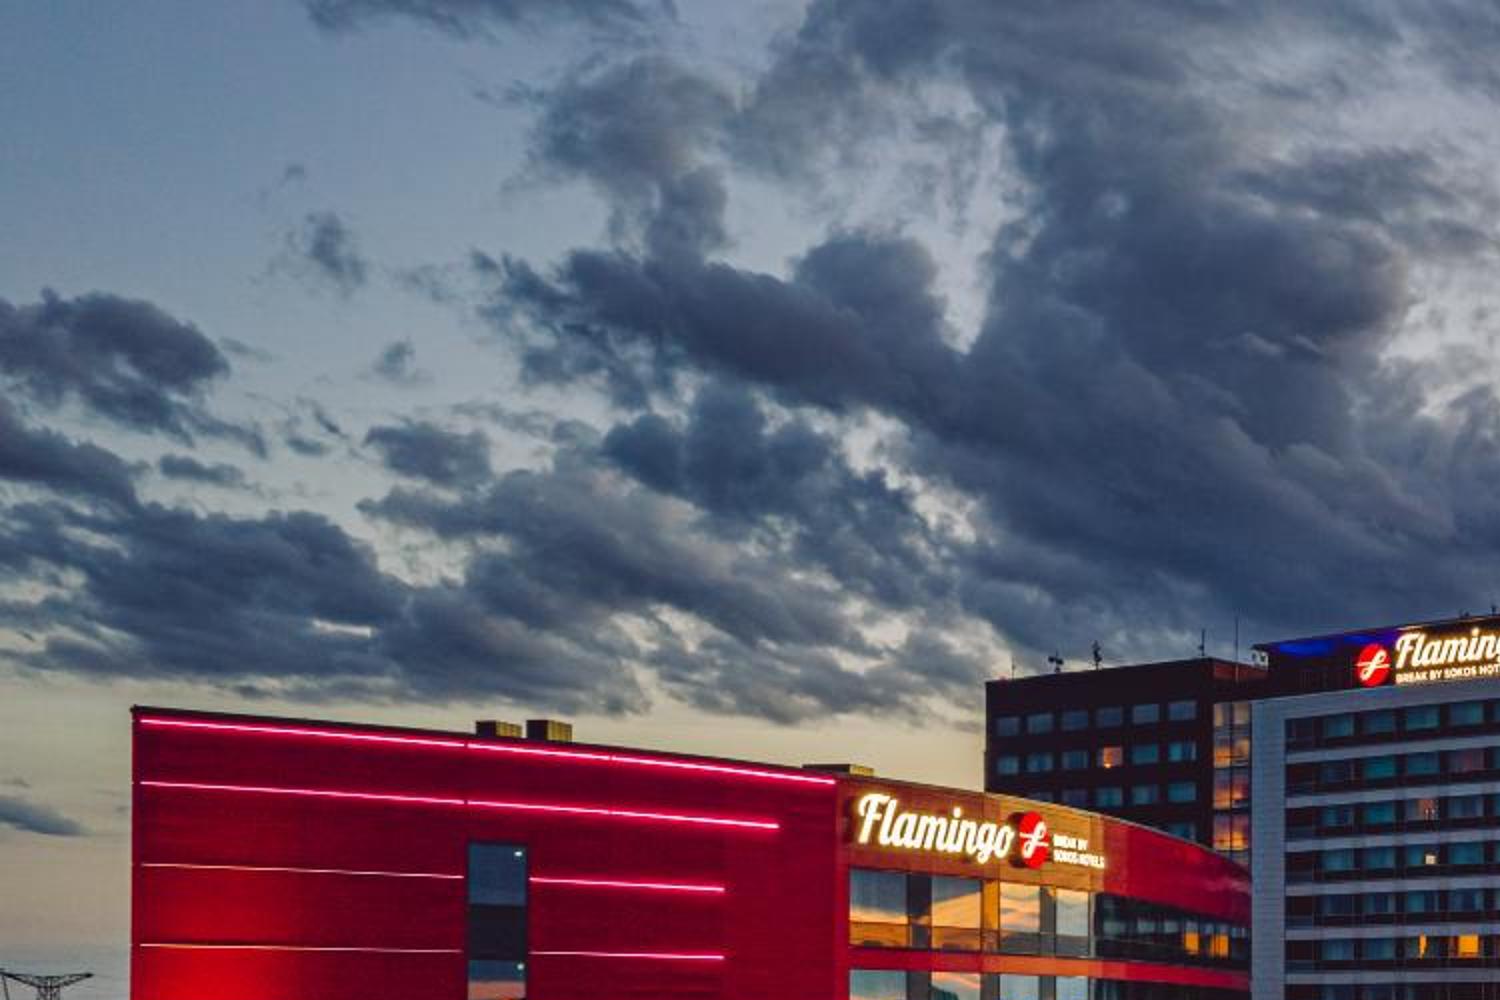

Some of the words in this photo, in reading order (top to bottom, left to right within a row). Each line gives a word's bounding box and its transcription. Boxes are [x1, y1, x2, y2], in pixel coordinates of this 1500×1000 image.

[1396, 671, 1429, 684] BREAK
[1429, 669, 1443, 680] BY
[1444, 667, 1477, 679] SOKOS
[857, 793, 1015, 864] Flamingo
